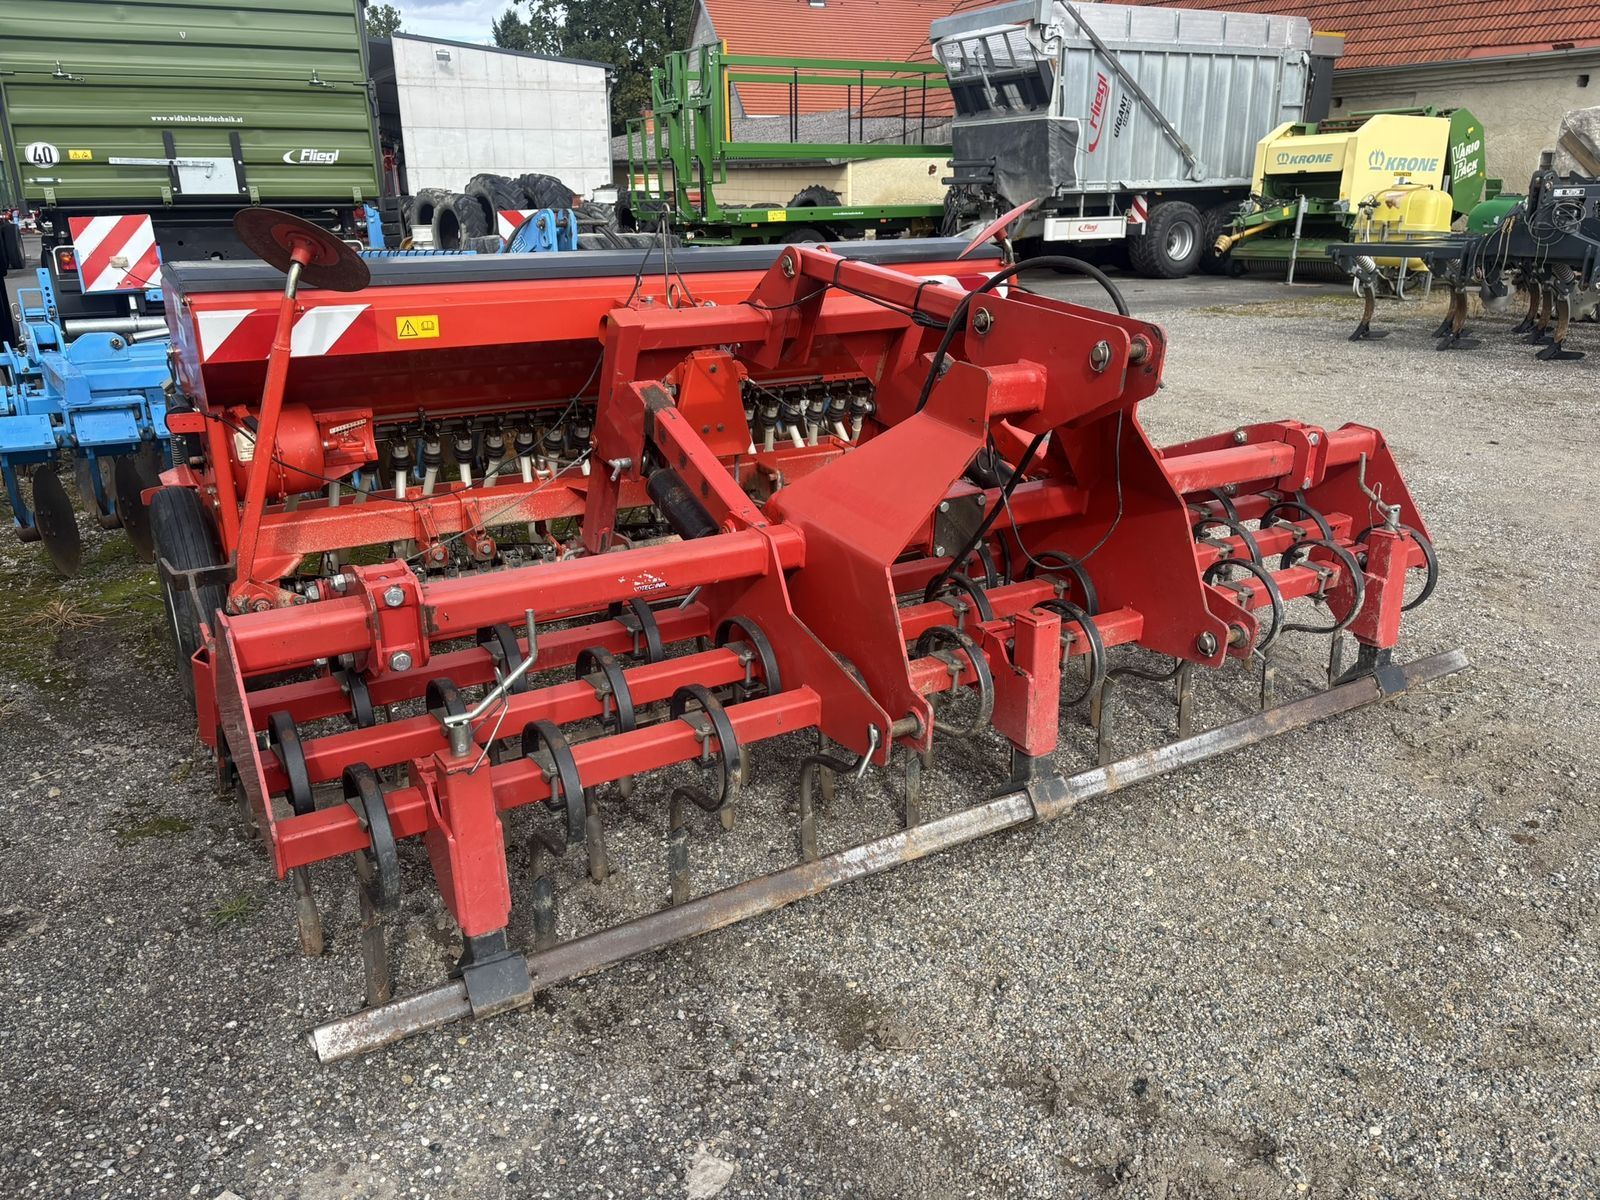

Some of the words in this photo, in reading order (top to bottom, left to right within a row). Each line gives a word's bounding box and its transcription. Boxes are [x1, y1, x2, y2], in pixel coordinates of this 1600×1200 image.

[151, 114, 243, 123] www.widhalm-landtechnik.at
[33, 146, 53, 164] 40
[300, 149, 340, 164] Fliegl
[1289, 153, 1334, 165] KRONE
[1384, 156, 1439, 172] KRONE
